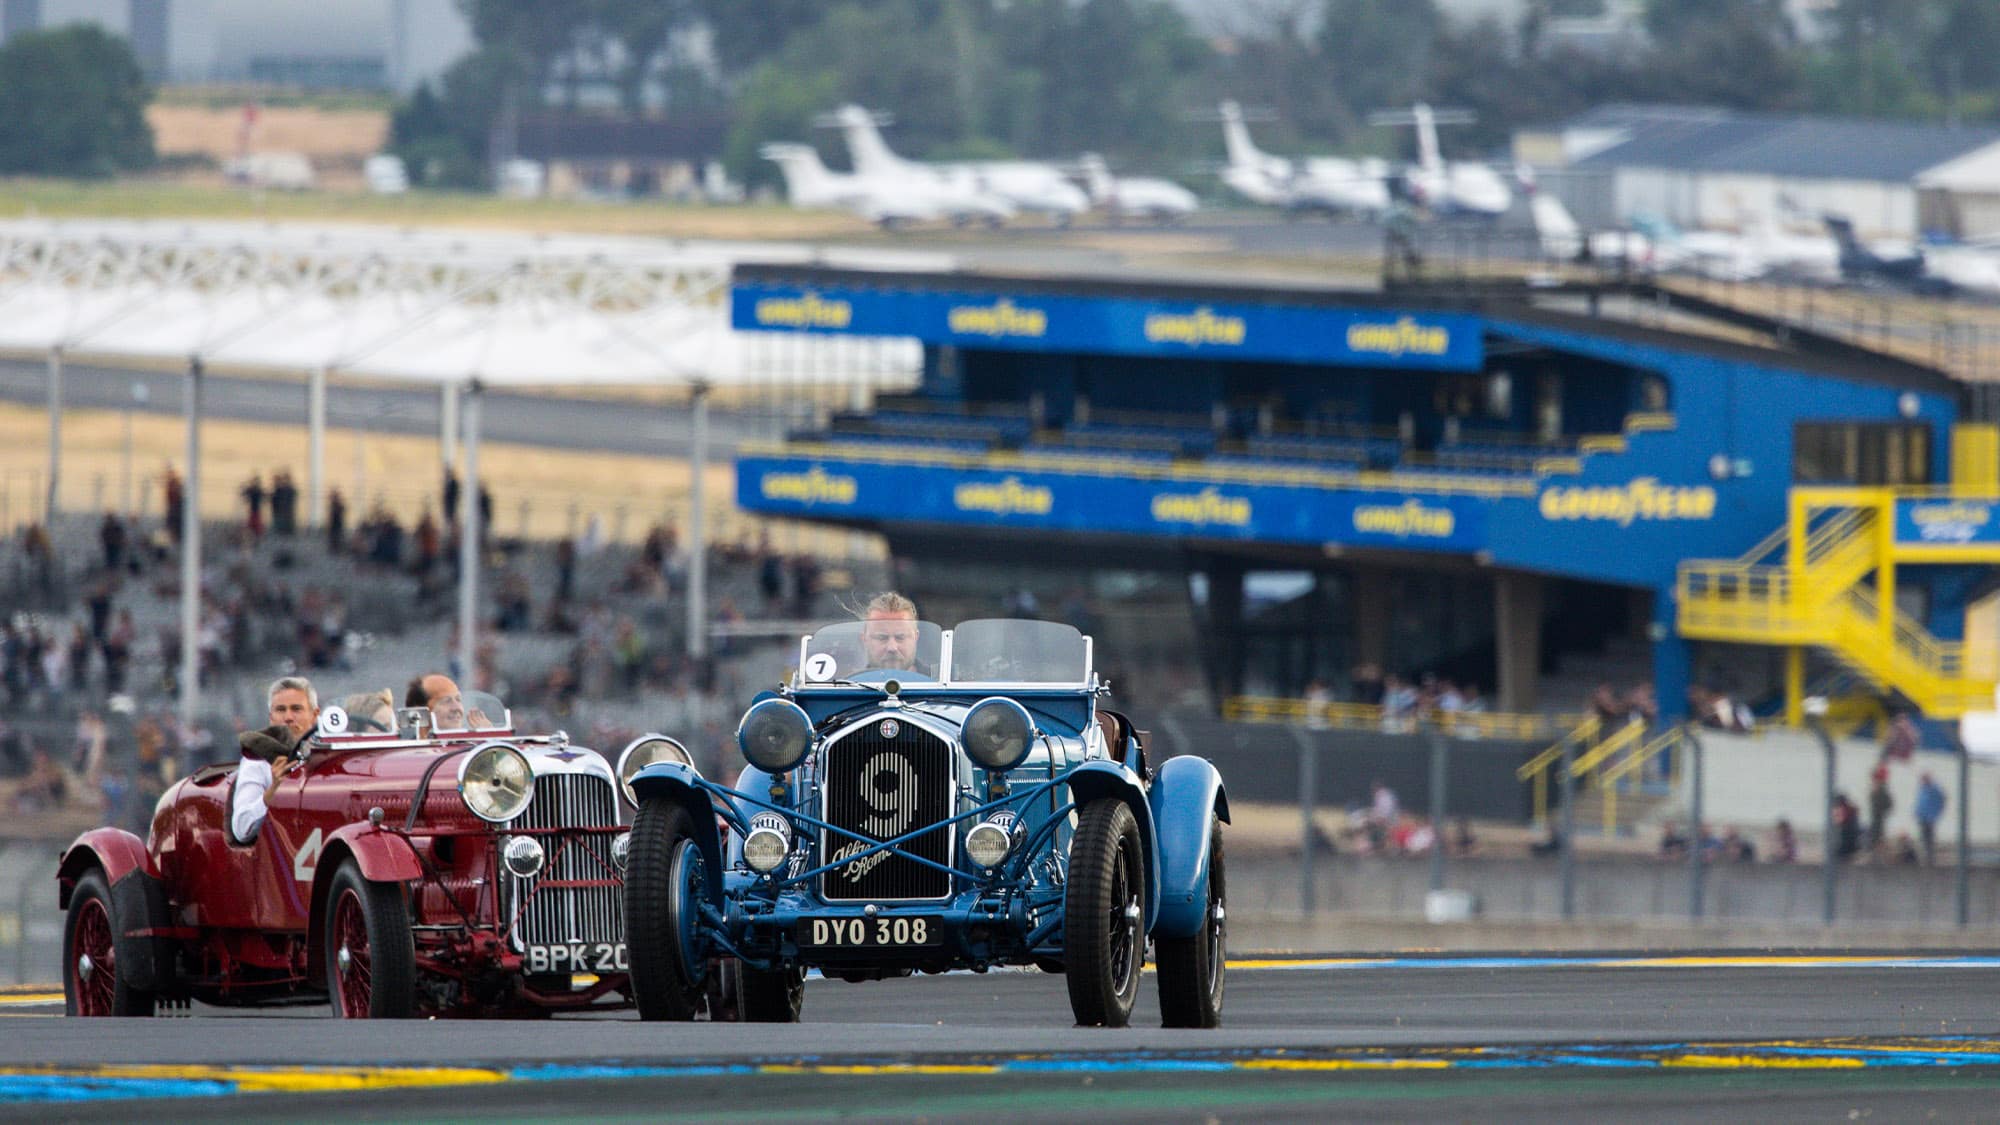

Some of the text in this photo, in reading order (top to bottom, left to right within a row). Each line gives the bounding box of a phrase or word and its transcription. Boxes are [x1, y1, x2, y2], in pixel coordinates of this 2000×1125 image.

[1540, 477, 1717, 527] GOODYEAR
[815, 660, 826, 675] 7
[330, 713, 340, 726] 8
[860, 752, 918, 838] 9
[813, 918, 927, 945] DYO 308
[530, 944, 588, 972] BPK
